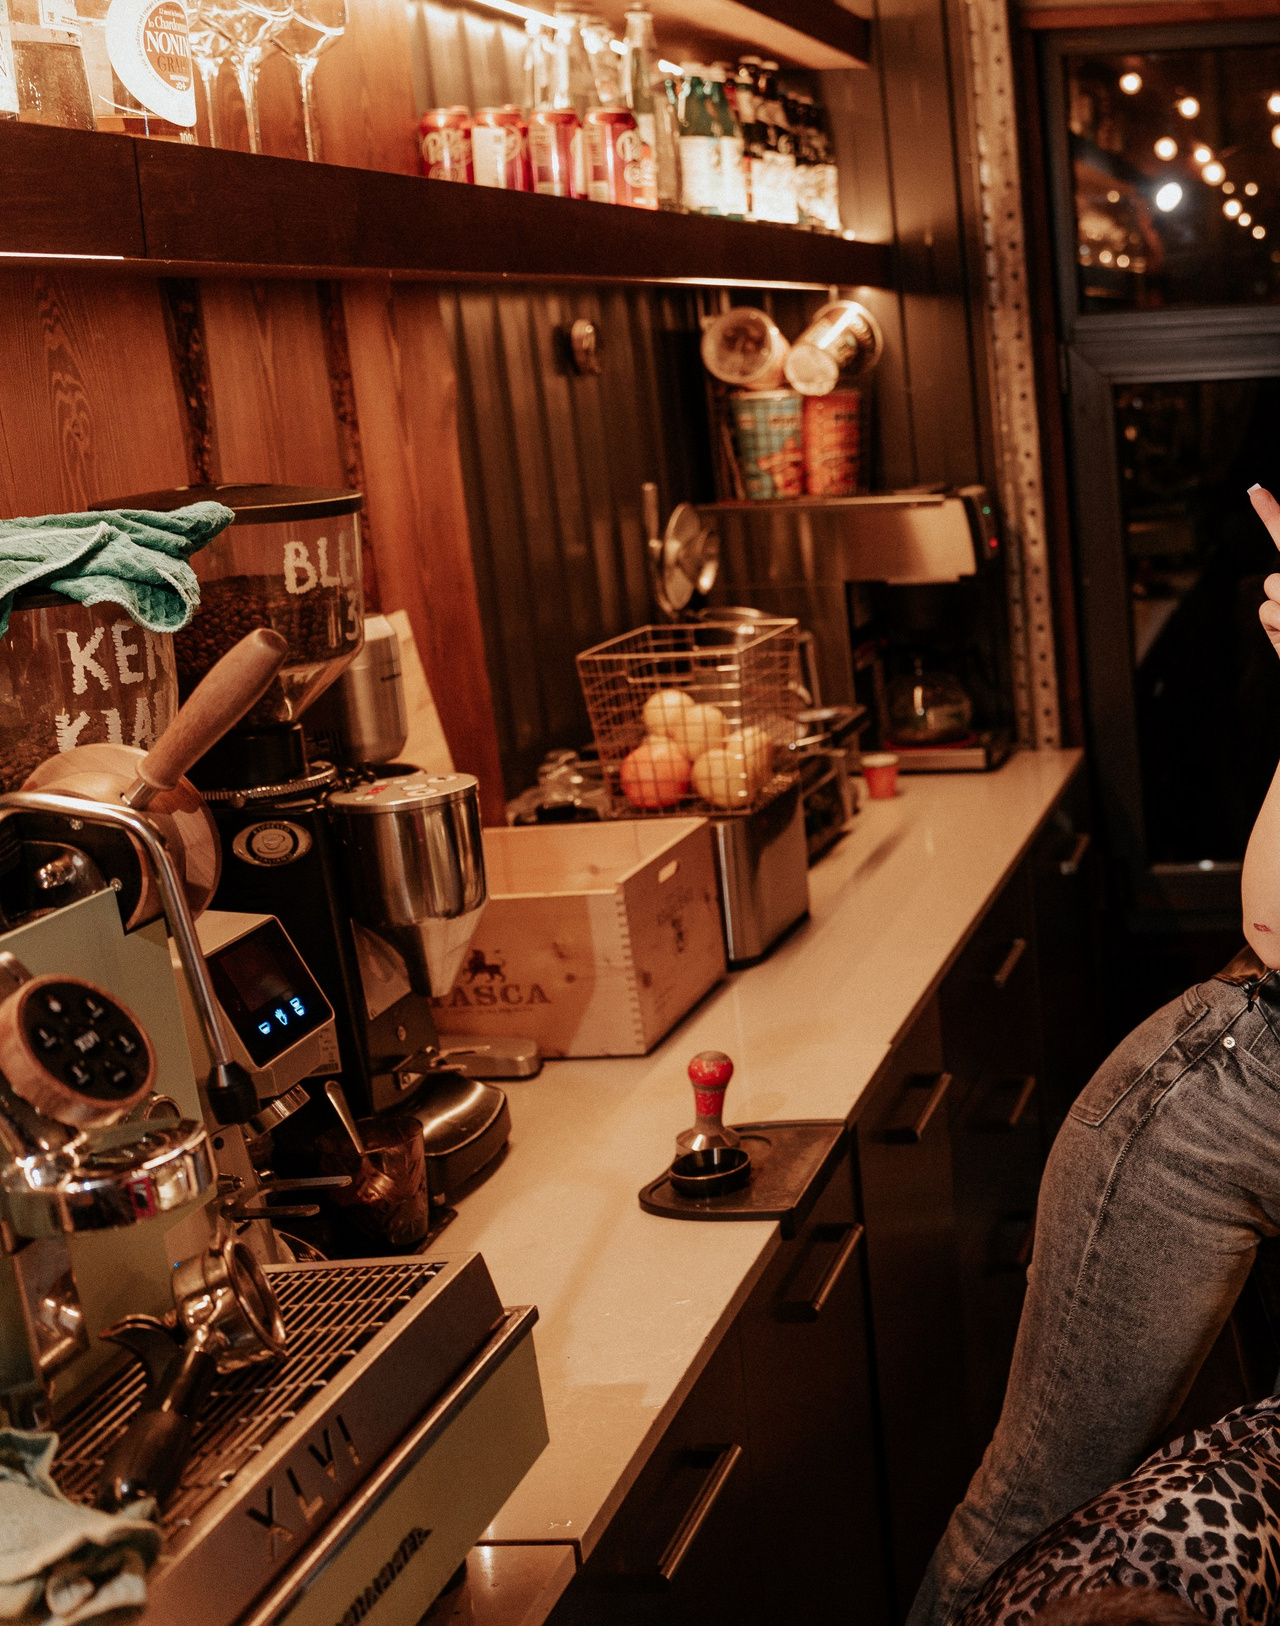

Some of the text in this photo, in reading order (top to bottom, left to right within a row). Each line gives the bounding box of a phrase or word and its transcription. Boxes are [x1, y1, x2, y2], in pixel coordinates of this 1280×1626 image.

[145, 30, 189, 57] NONIN
[430, 984, 552, 1010] ASCA
[246, 1414, 361, 1563] XLVI
